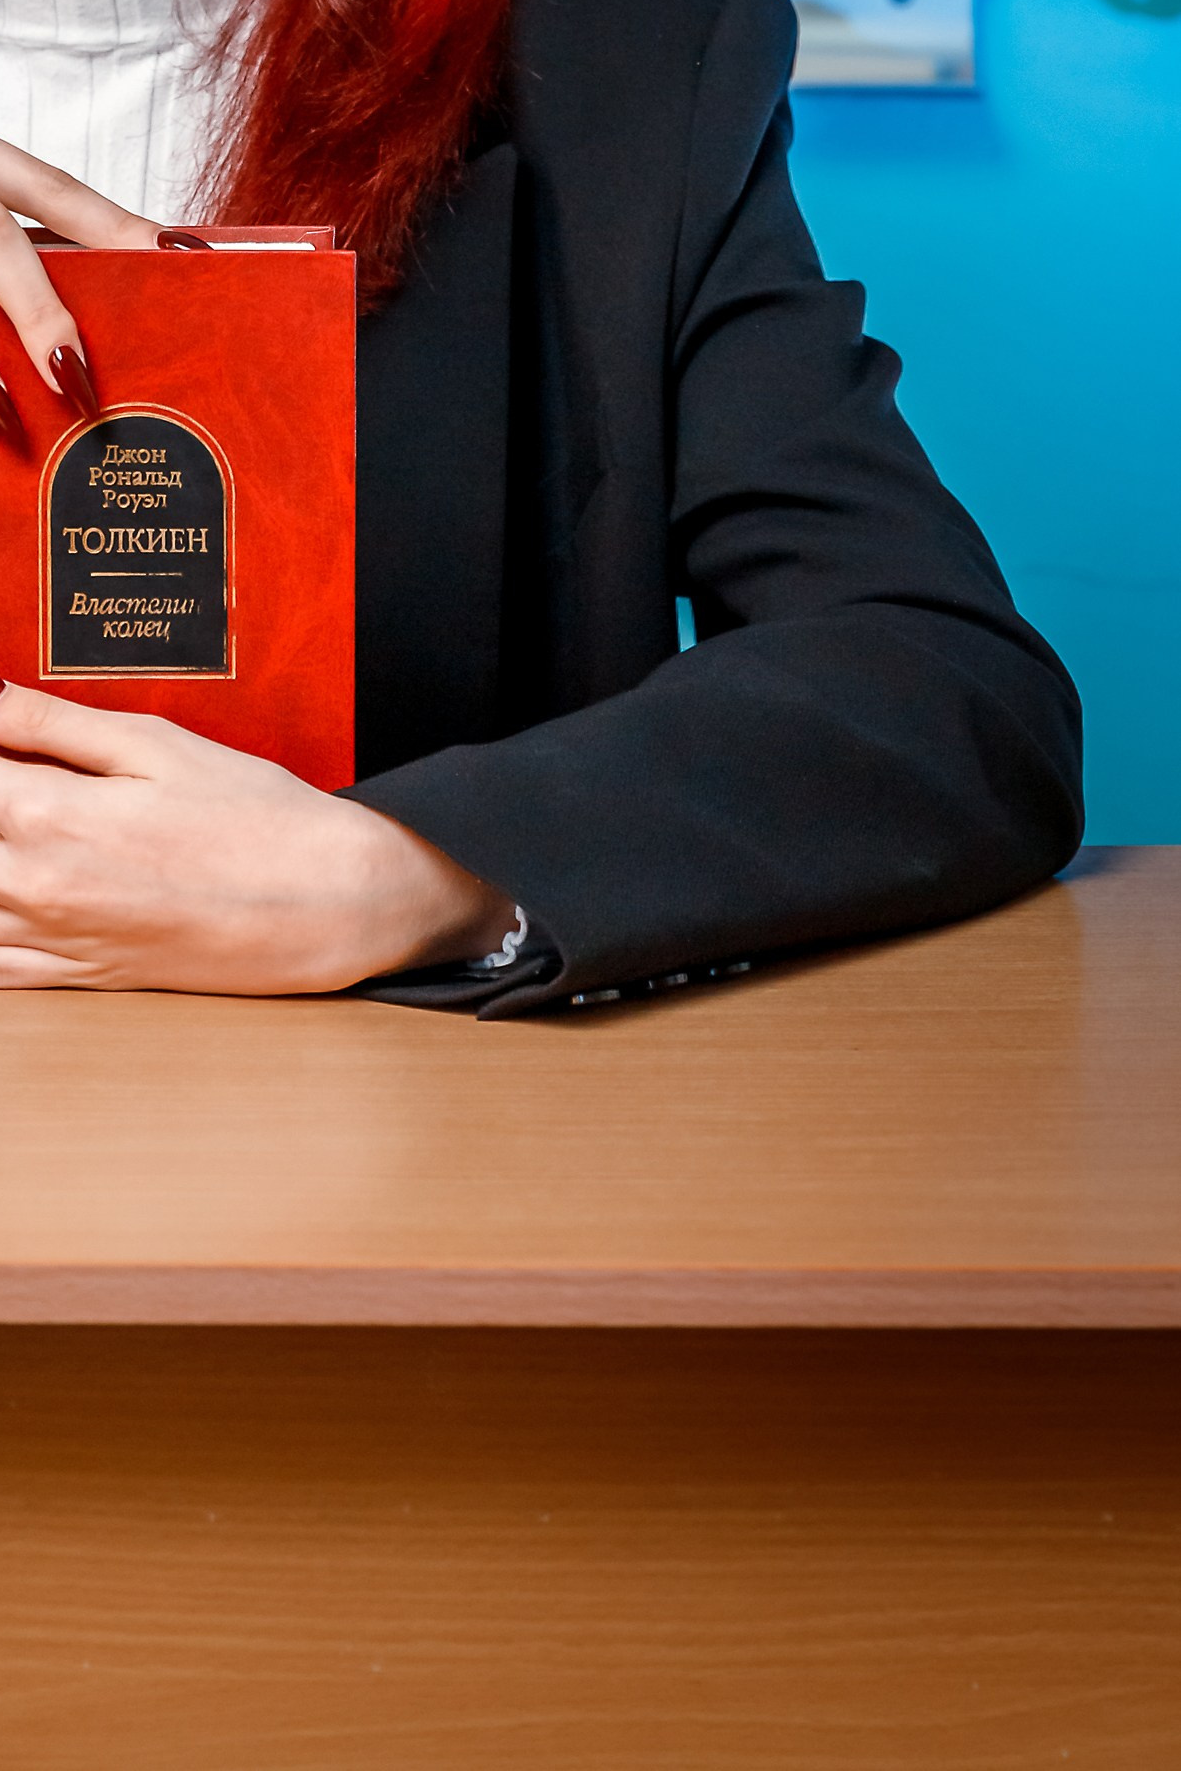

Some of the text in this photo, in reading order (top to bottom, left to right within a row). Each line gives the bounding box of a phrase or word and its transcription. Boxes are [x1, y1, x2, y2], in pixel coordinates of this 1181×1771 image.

[102, 444, 166, 467] Джон
[88, 466, 183, 489] Рональд
[101, 489, 168, 514] Роуэл
[61, 526, 209, 555] ТОЛКИЕН
[102, 619, 171, 643] колец
